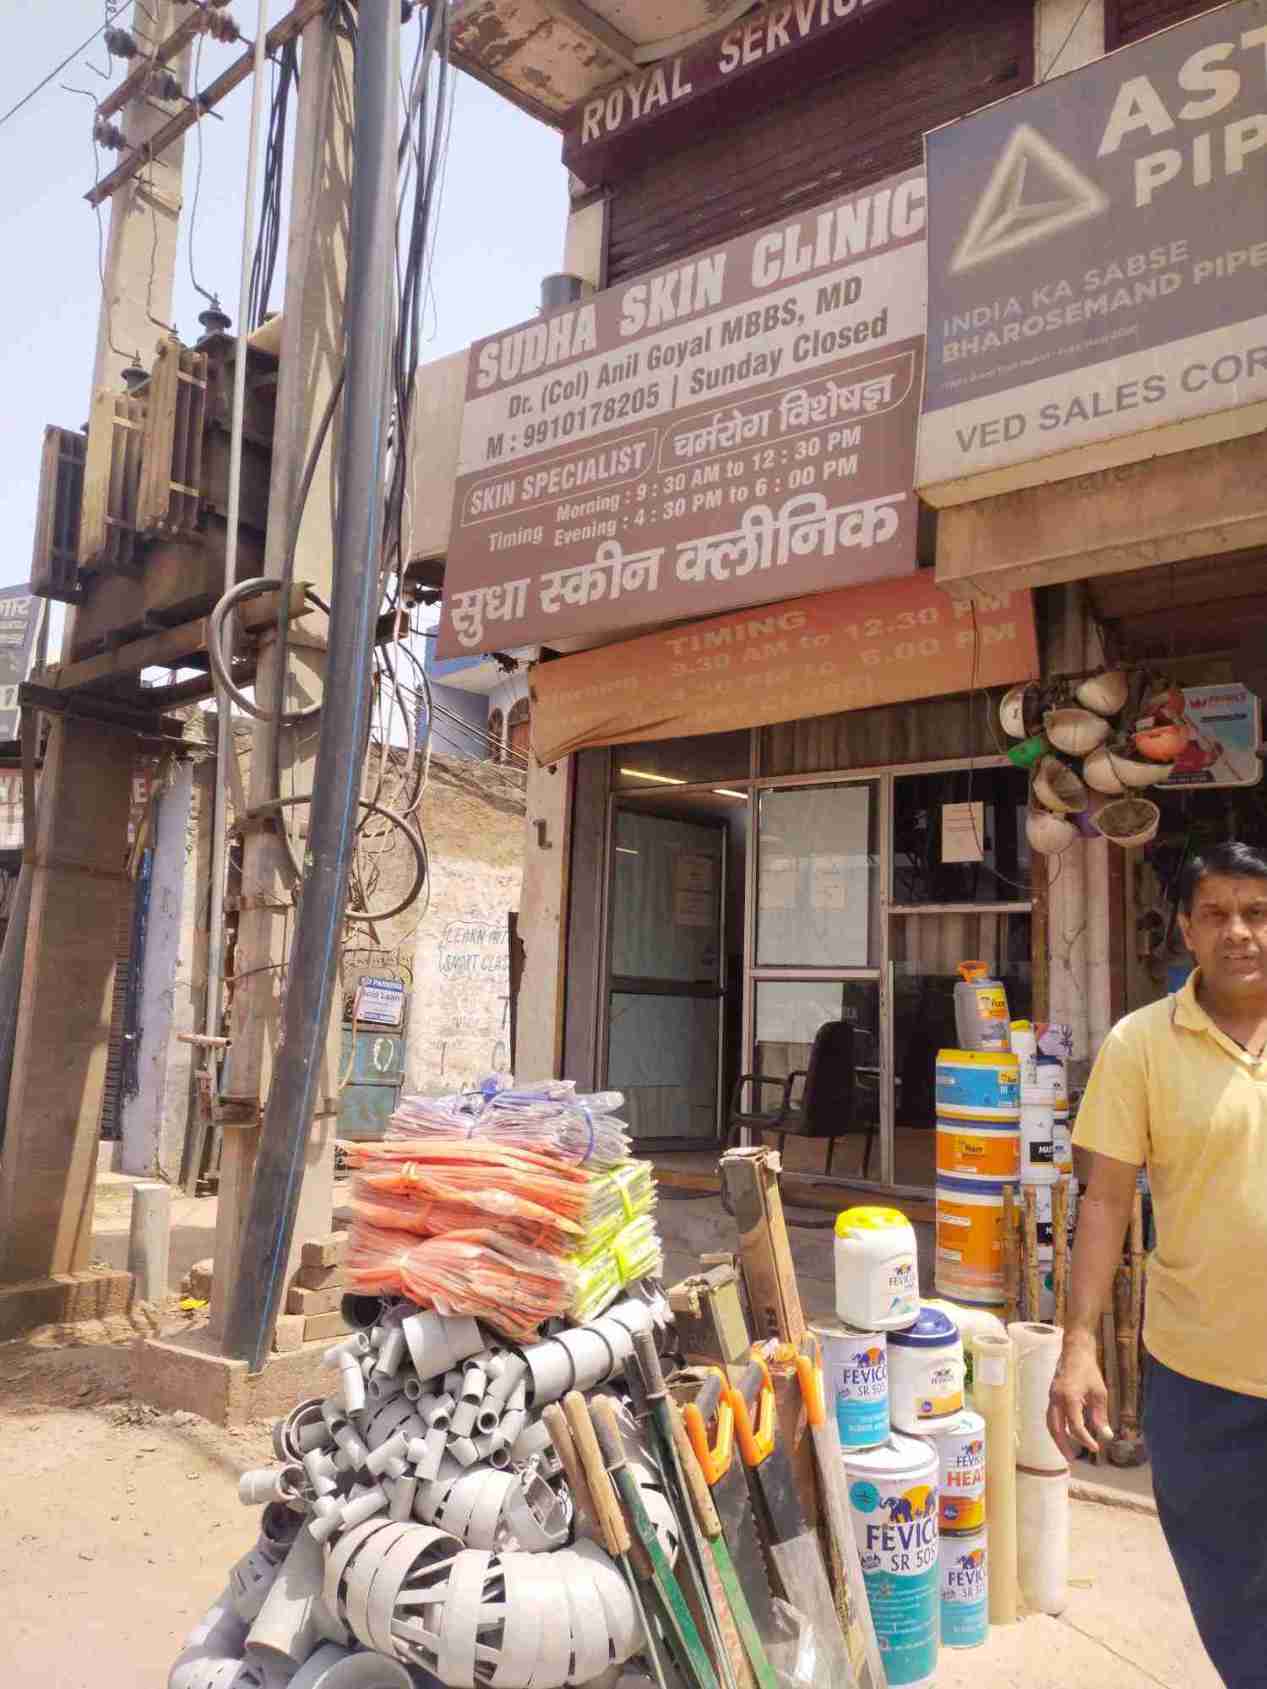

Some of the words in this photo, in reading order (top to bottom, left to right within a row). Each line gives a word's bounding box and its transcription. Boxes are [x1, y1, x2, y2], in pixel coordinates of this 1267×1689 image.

[581, 57, 692, 145] ROYAL
[475, 303, 598, 390] SUDHA
[619, 252, 727, 338] SKIN
[751, 177, 927, 290] CLINIC
[942, 271, 1183, 364] BHAROSEMAND
[943, 296, 1023, 337] INDIA
[1032, 278, 1073, 310] KA
[1084, 239, 1190, 292] SABSE
[508, 394, 533, 419] Dr.
[541, 370, 589, 413] (Col)
[598, 351, 637, 390] Anil
[647, 327, 711, 373] Goyal
[720, 297, 804, 348] MBBS,
[816, 275, 862, 315] MD
[523, 381, 660, 449] 9910178205
[690, 347, 784, 395] Sunday
[792, 306, 889, 362] Closed
[955, 412, 1027, 454] VED
[1039, 373, 1168, 432] SALES
[470, 480, 515, 515] SKIN
[521, 441, 647, 500] SPECIALIST
[553, 519, 617, 547] Evening
[691, 486, 722, 513] PM
[729, 484, 748, 505] to
[823, 453, 858, 481] PM
[556, 493, 620, 522] Morning
[691, 463, 720, 489] AM
[726, 459, 744, 478] to
[827, 425, 861, 452] PM
[450, 578, 531, 648] सुधा
[539, 539, 665, 614] स्कीन
[675, 491, 908, 582] क्लीनिक
[488, 525, 544, 552] Timing
[664, 609, 808, 657] TIMING
[890, 1552, 911, 1572] SR
